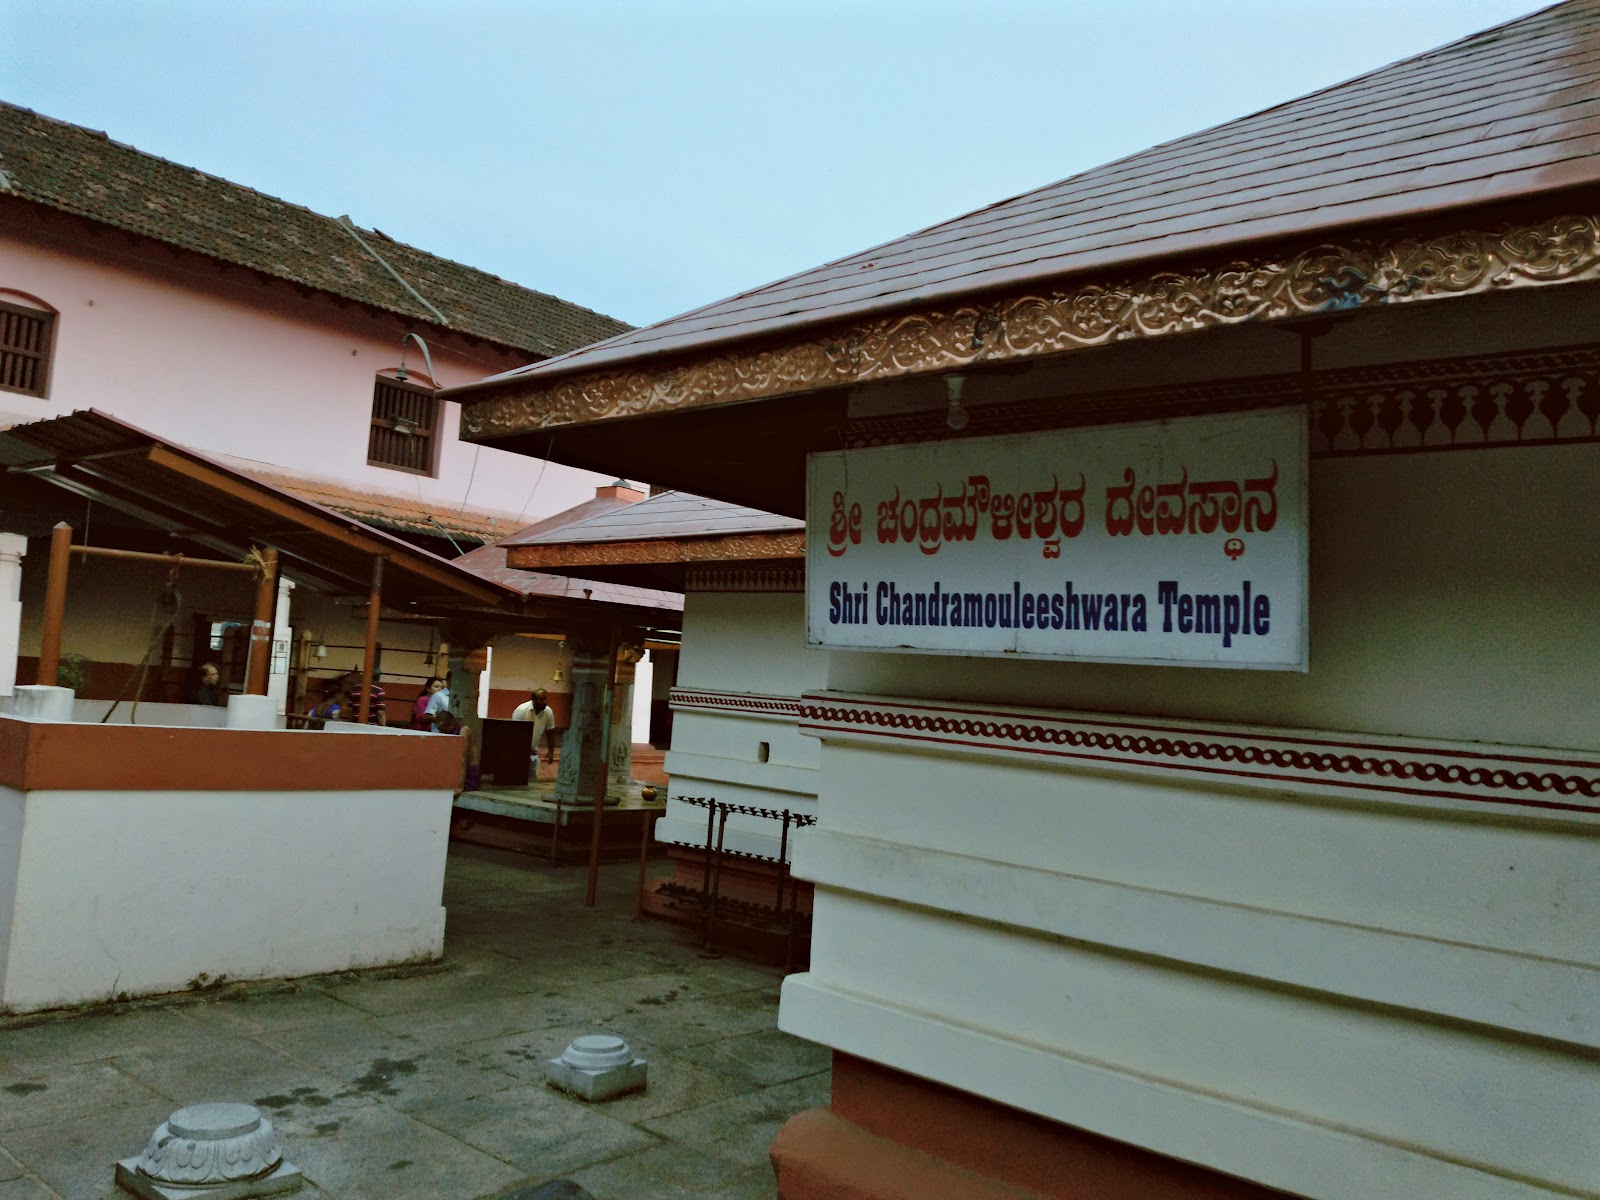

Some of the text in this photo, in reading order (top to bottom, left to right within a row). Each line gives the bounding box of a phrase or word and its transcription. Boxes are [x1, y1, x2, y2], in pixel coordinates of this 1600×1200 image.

[827, 458, 1278, 561] ಶ್ರೀ ಚಂದ್ರಮೌಳೀಶ್ವರ ದೇವಸ್ಥಾನ
[829, 580, 1271, 648] Shri Chandramouleeshwara Temple
